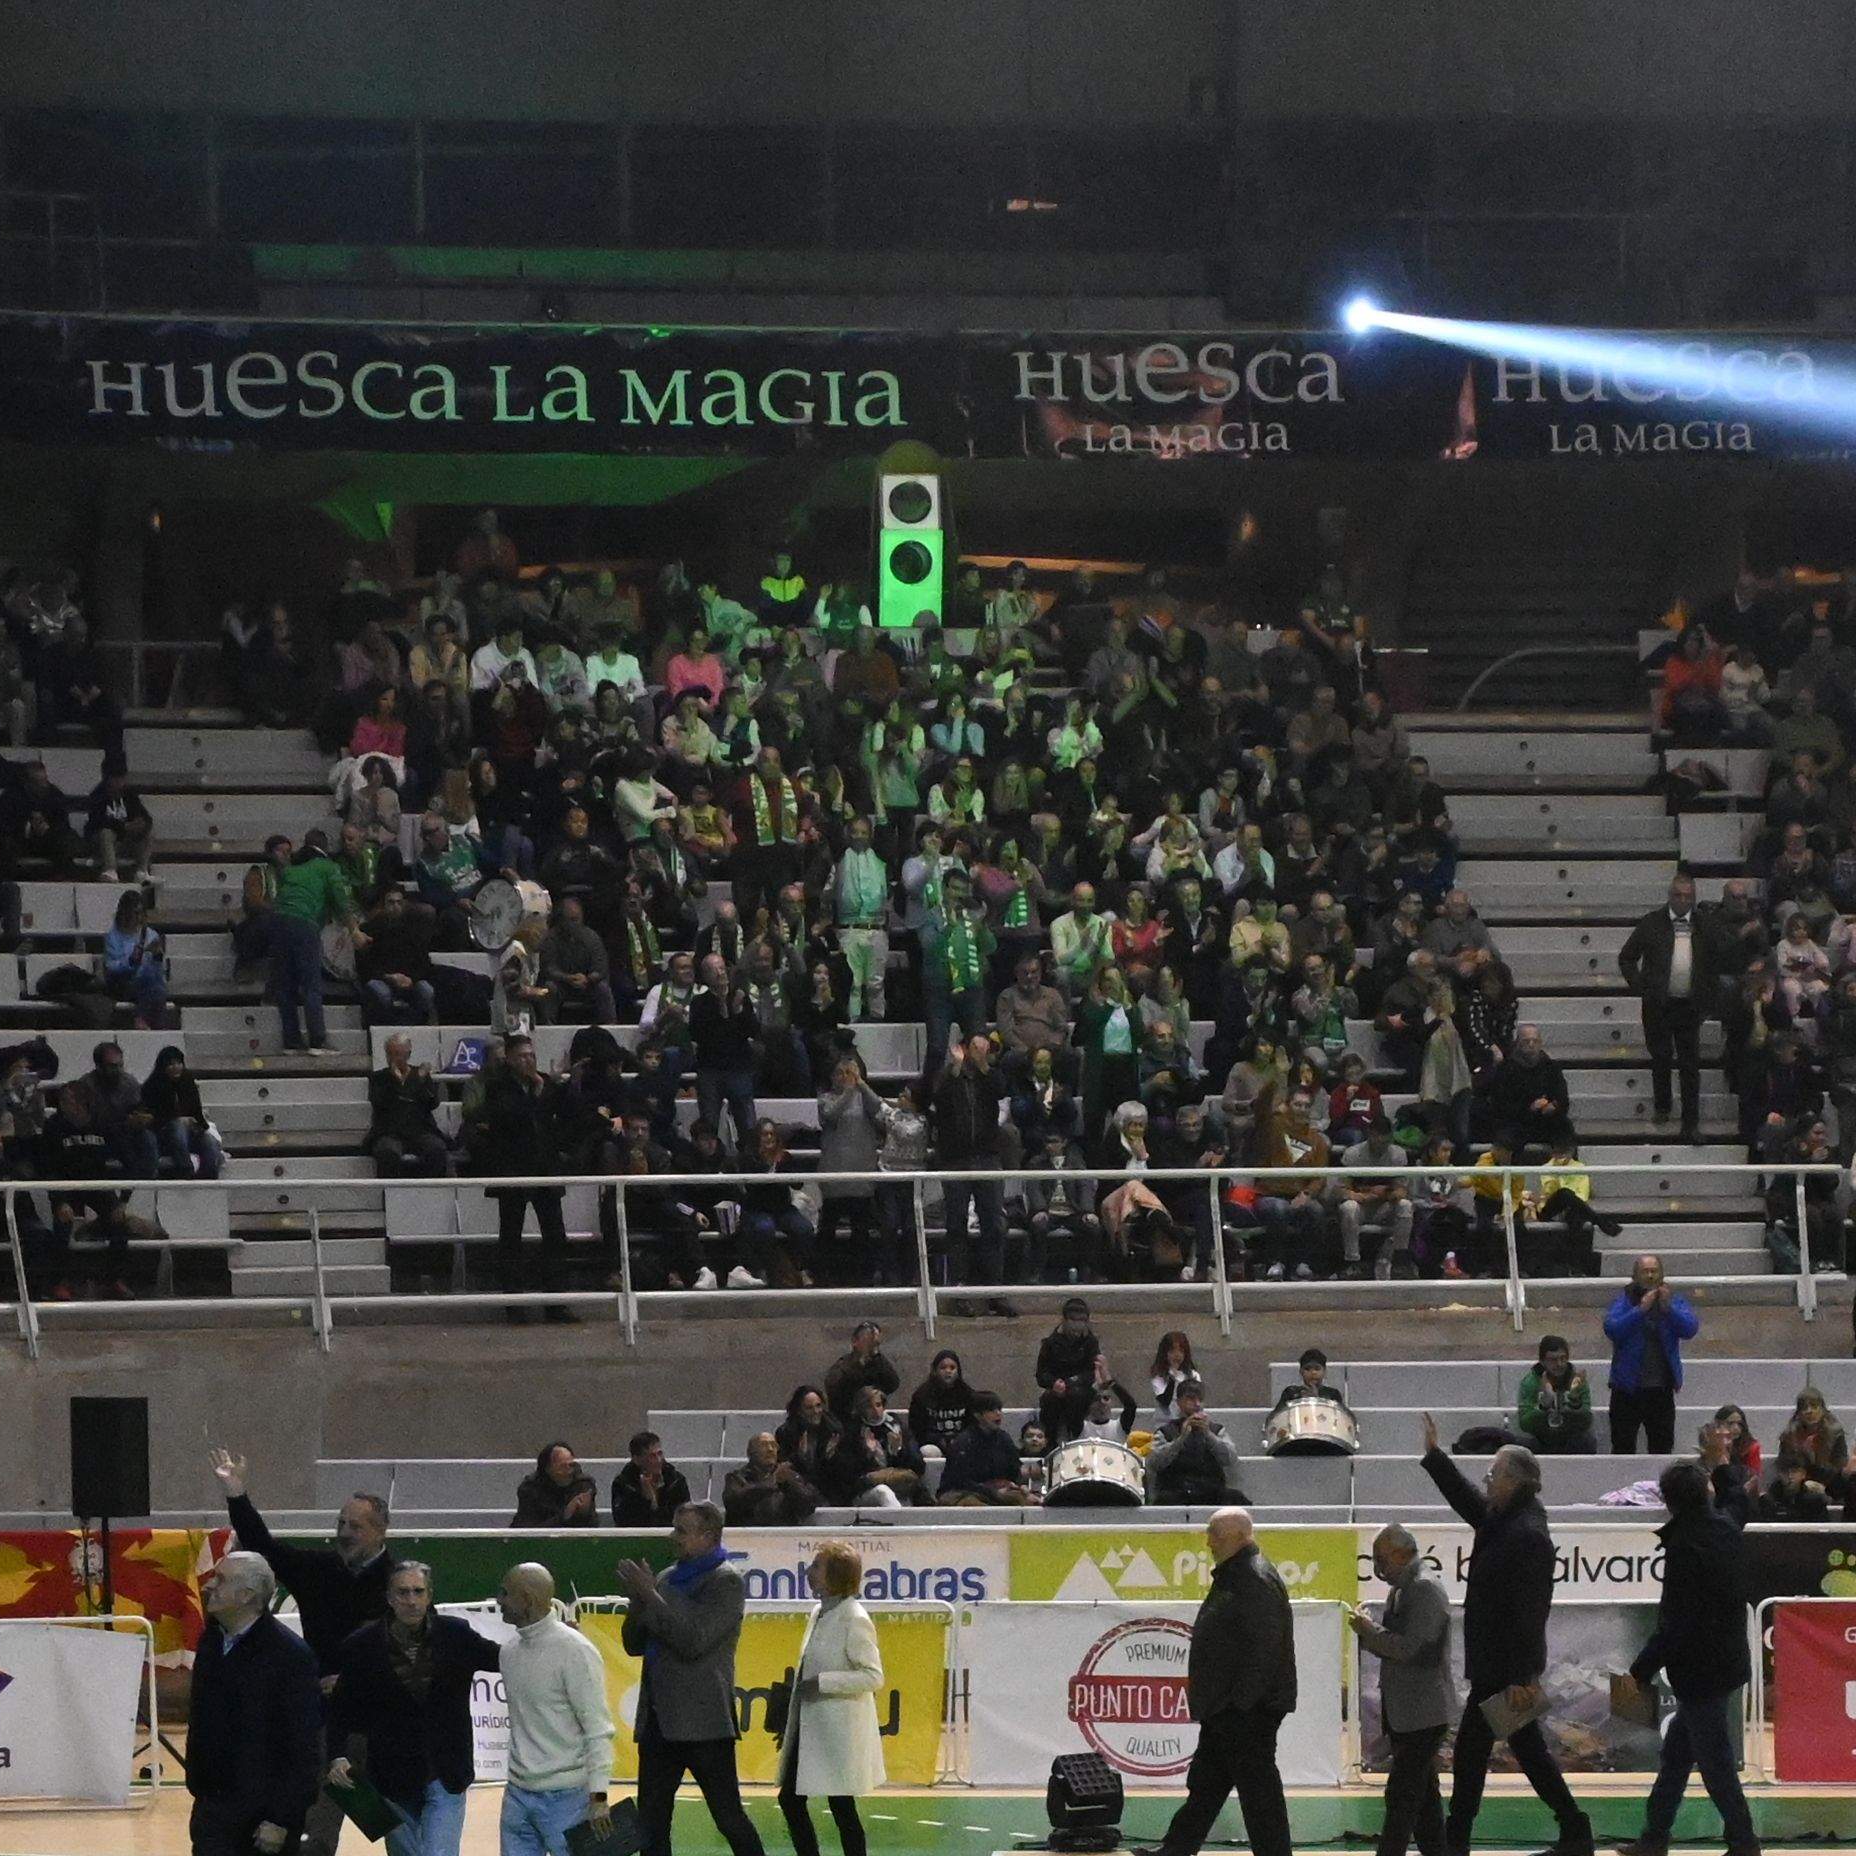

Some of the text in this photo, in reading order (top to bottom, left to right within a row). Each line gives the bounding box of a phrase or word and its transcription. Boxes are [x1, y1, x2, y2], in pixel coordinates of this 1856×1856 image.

[489, 363, 596, 425] La
[1083, 421, 1136, 454] La
[1548, 422, 1602, 453] La
[1126, 1642, 1186, 1664] PREMIUM
[1075, 1683, 1153, 1719] PUNTO
[1126, 1737, 1182, 1758] QUALITY
